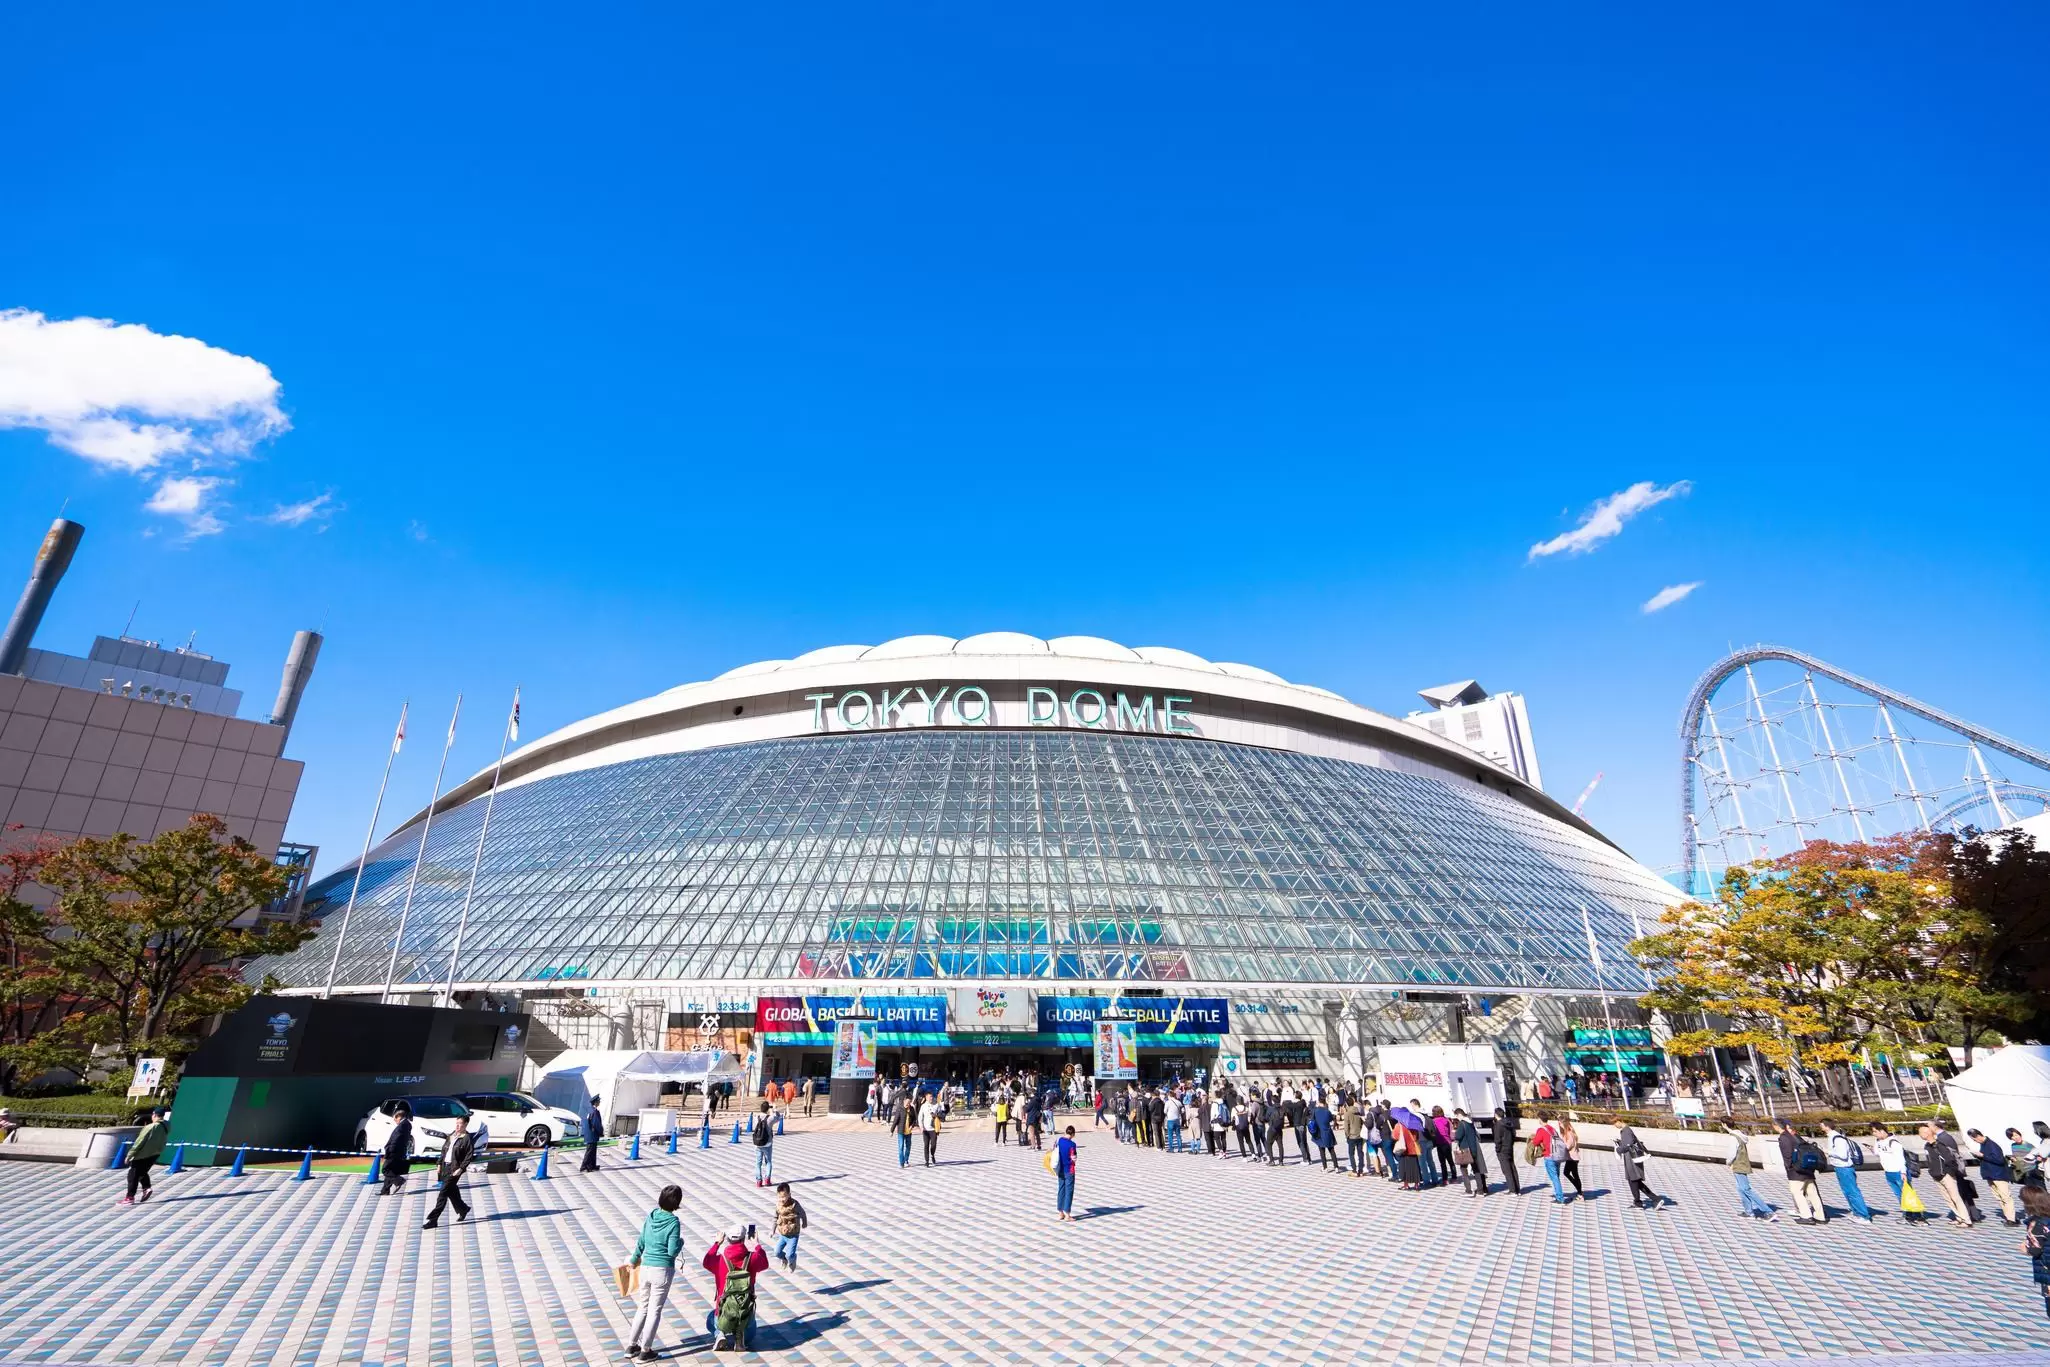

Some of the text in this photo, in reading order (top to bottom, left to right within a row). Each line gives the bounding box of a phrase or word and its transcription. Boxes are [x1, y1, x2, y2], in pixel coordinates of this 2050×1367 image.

[805, 685, 1194, 732] TOKYO DOME
[977, 990, 1006, 1003] Tokyo
[983, 1001, 1008, 1009] Dome
[764, 1007, 938, 1022] GLOBAL BASELL BATTLE
[978, 1007, 1004, 1017] City
[1046, 1008, 1220, 1022] GLOBAL SEBALL BATTLE
[984, 1035, 992, 1045] 22
[992, 1035, 999, 1045] 22
[260, 1050, 285, 1058] FINALS
[1384, 1073, 1424, 1085] BASEBALL
